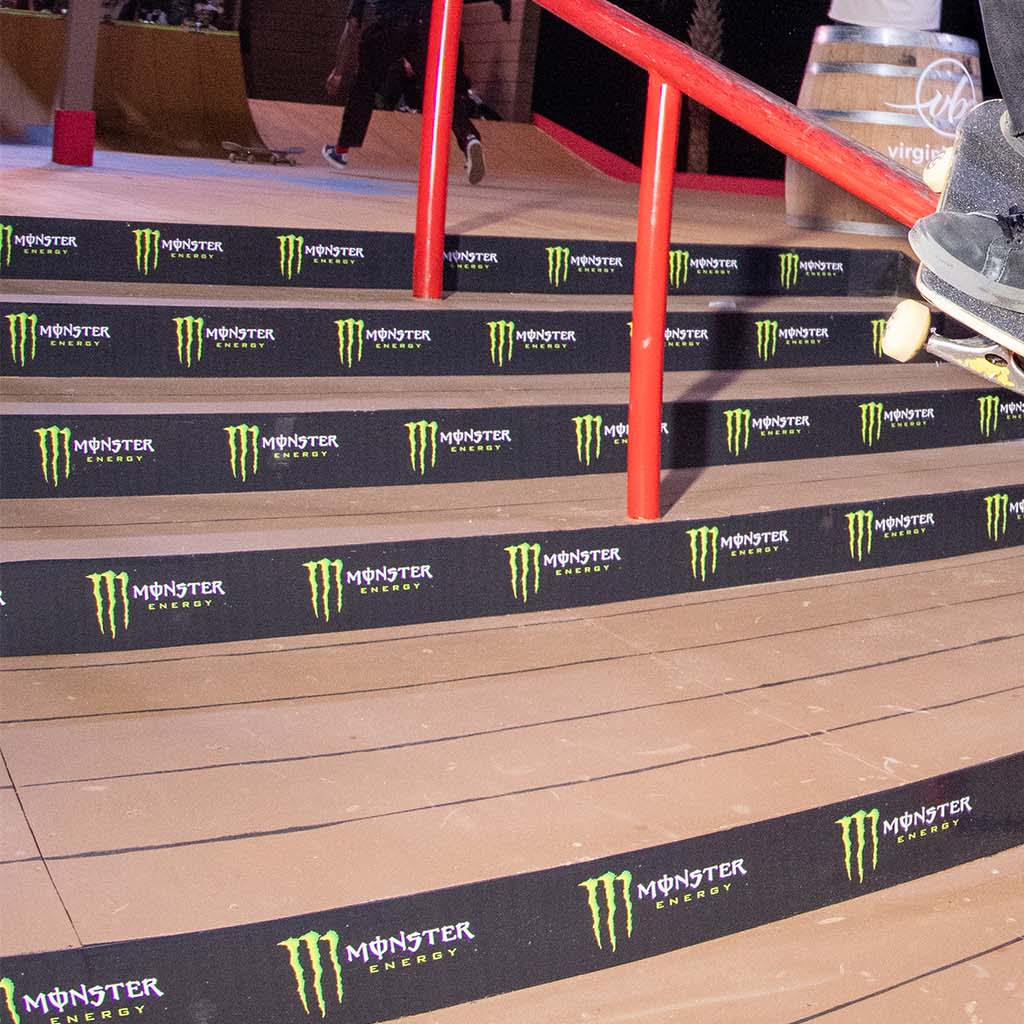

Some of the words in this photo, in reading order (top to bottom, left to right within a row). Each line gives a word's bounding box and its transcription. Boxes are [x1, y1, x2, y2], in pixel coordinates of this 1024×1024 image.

[312, 257, 356, 265] ENERGY
[696, 268, 731, 276] ENERGY
[664, 327, 708, 341] ONSTER
[891, 419, 928, 427] ENERGY
[760, 428, 802, 436] ENERGY
[449, 444, 501, 453] ENERGY
[86, 455, 142, 463] ENERGY
[274, 450, 327, 459] ENERGY
[883, 528, 926, 539] ENERGY
[729, 545, 778, 557] ENERGY
[555, 564, 609, 576] ENERGY
[360, 583, 419, 594] ENERGY
[148, 600, 211, 611] ENERGY
[897, 820, 958, 844] ENERGY
[656, 883, 731, 909] ENERGY
[368, 948, 456, 973] ENERGY
[50, 1006, 144, 1024] ENERGY
